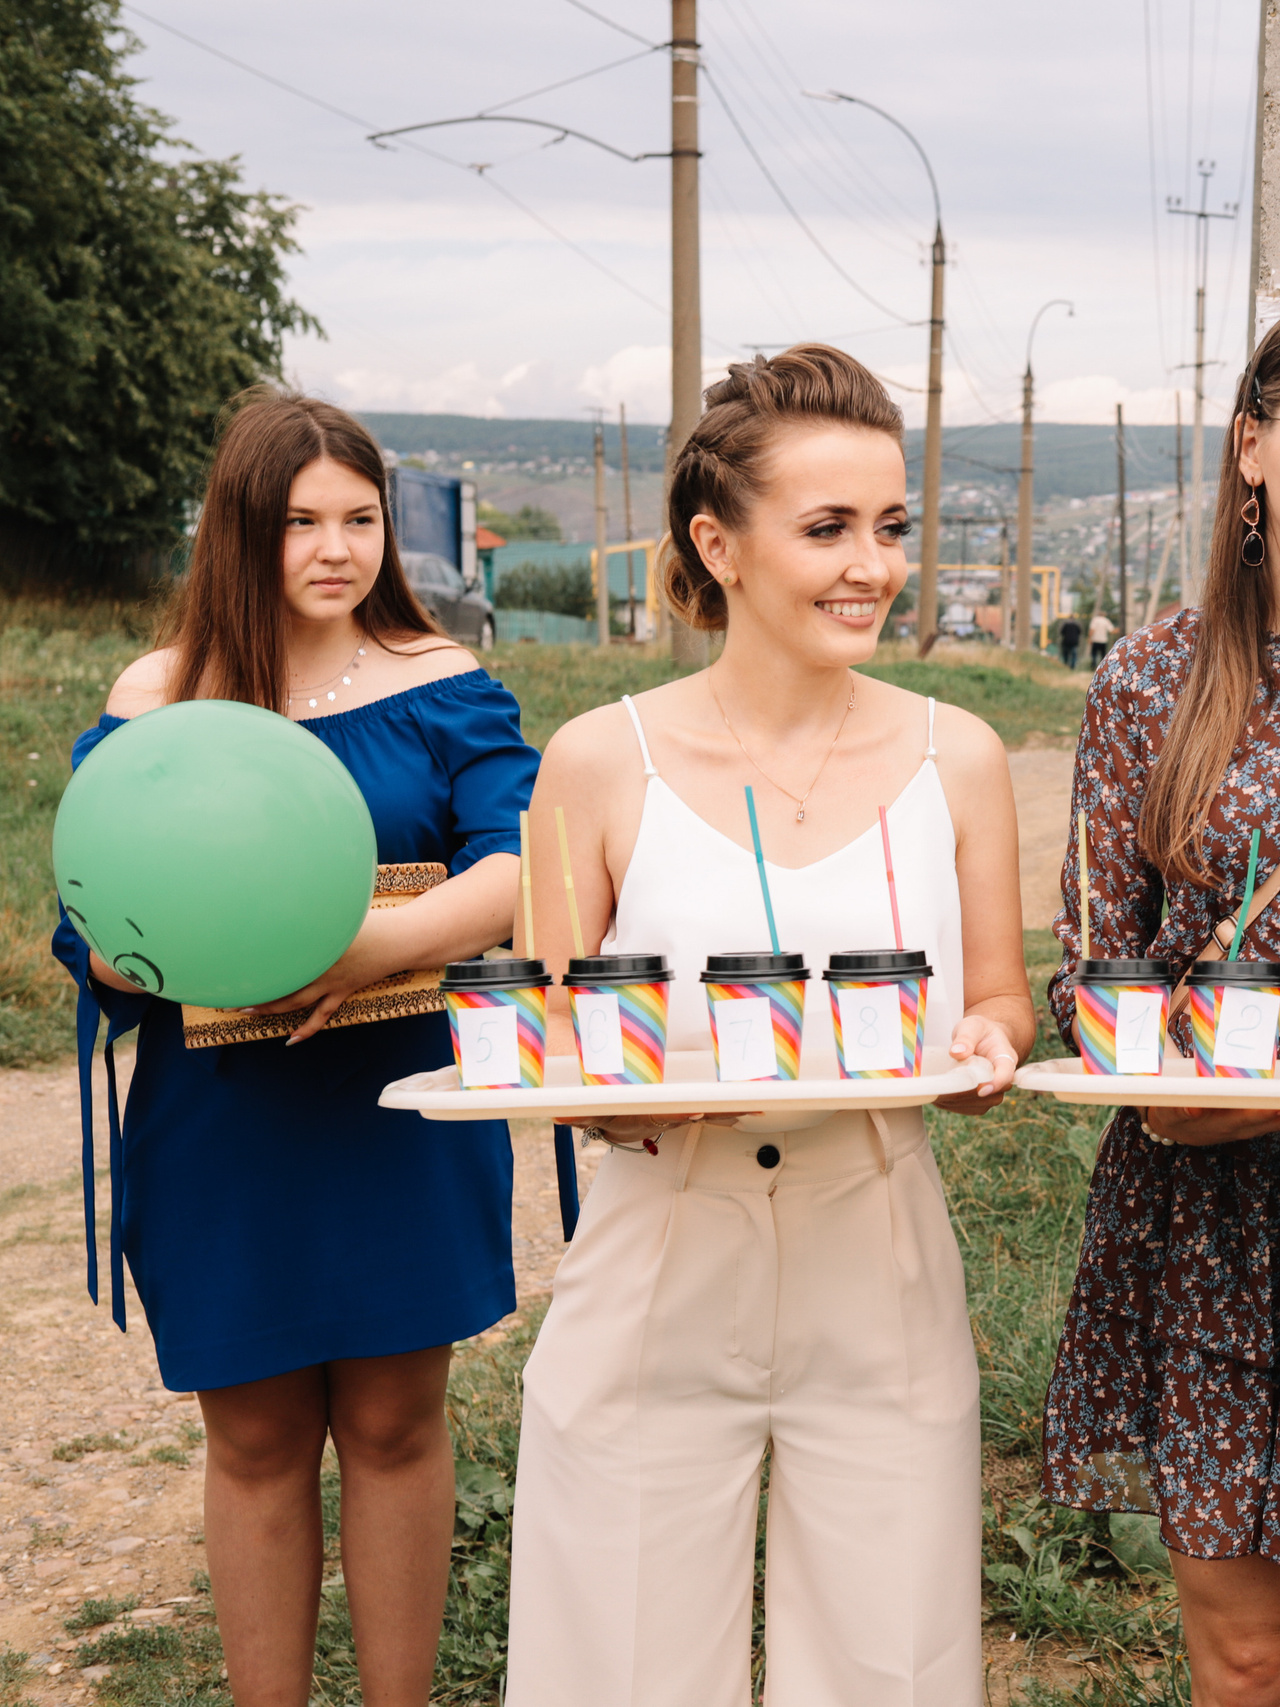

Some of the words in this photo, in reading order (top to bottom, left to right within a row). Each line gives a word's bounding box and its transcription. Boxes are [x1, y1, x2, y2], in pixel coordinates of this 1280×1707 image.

[475, 1021, 498, 1063] 5
[587, 1008, 609, 1053] 6
[729, 1018, 756, 1061] 7
[857, 1006, 879, 1048] 8
[1122, 1005, 1151, 1051] 1
[1225, 1004, 1262, 1050] 2
